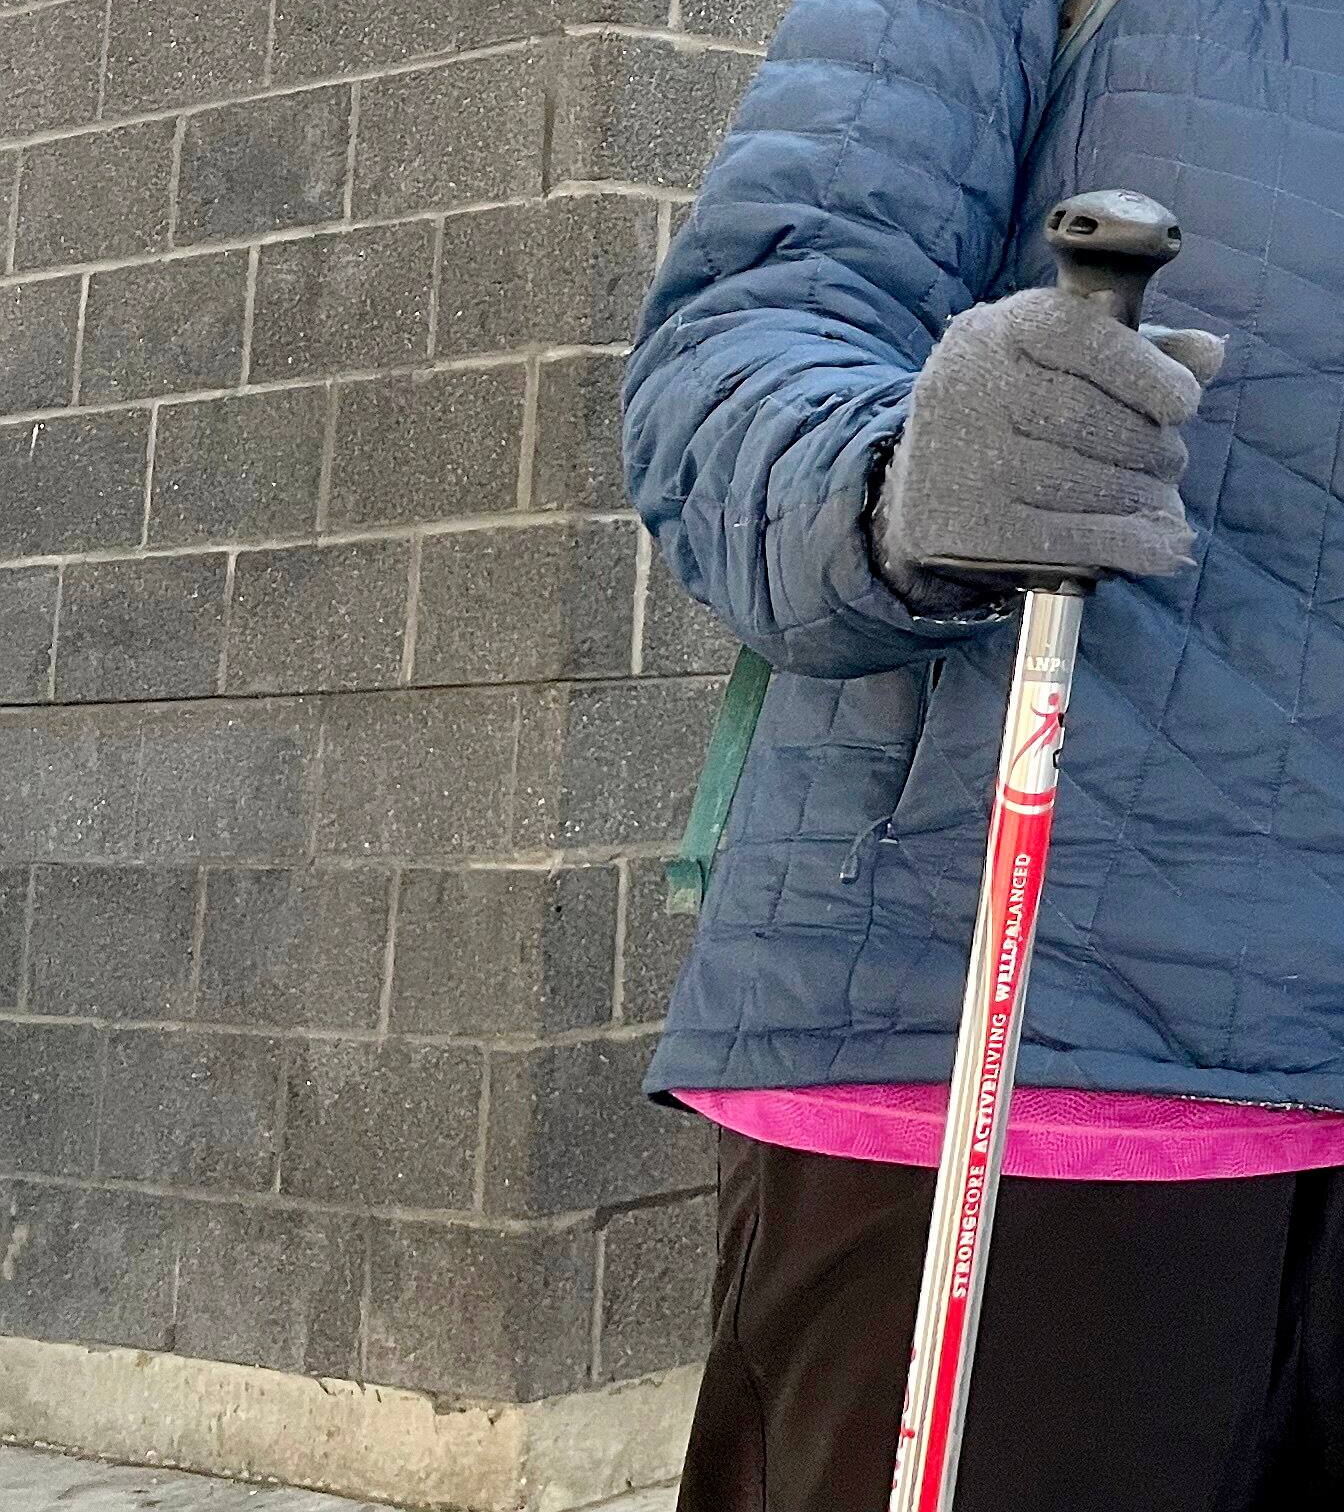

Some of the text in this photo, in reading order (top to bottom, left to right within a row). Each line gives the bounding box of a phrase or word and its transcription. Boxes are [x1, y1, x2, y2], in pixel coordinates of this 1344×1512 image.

[952, 852, 1031, 1299] STRONGCORE ACTIVELIVING WELLBALANCED
